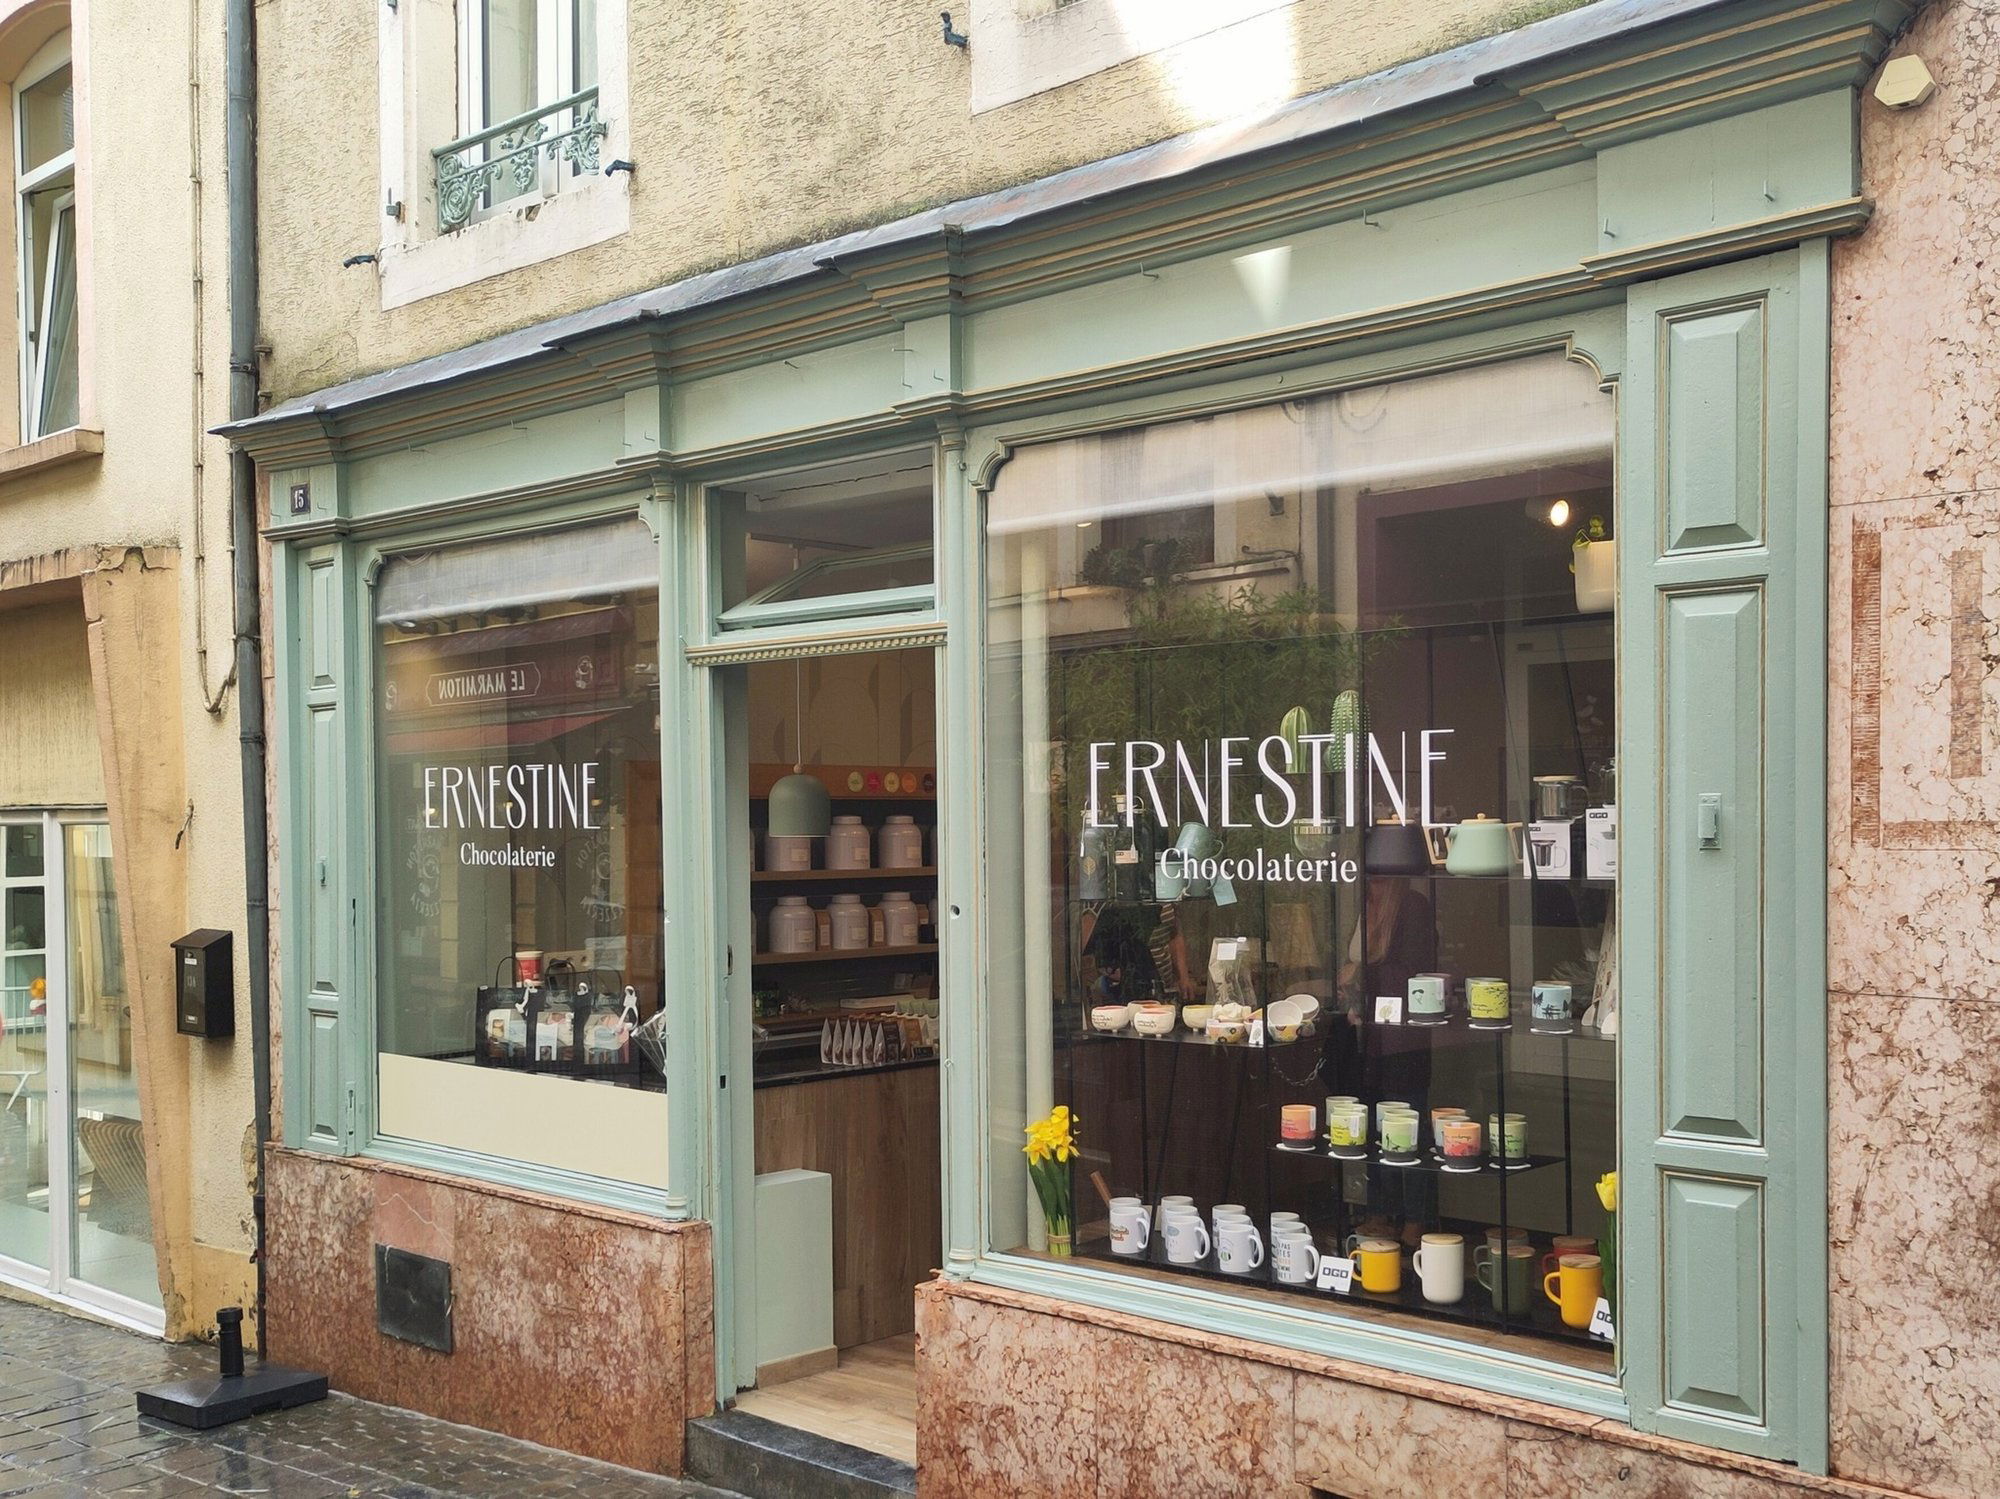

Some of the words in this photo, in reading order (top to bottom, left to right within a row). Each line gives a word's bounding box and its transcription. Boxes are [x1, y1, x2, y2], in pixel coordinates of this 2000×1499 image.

[293, 489, 304, 508] 15
[1089, 729, 1457, 828] ERNESTINE
[424, 762, 601, 829] ERNESTINE
[460, 842, 555, 867] Chocolaterie
[1160, 847, 1358, 883] Chocolaterie
[1322, 1267, 1349, 1279] OGO
[1596, 1310, 1614, 1324] OG
